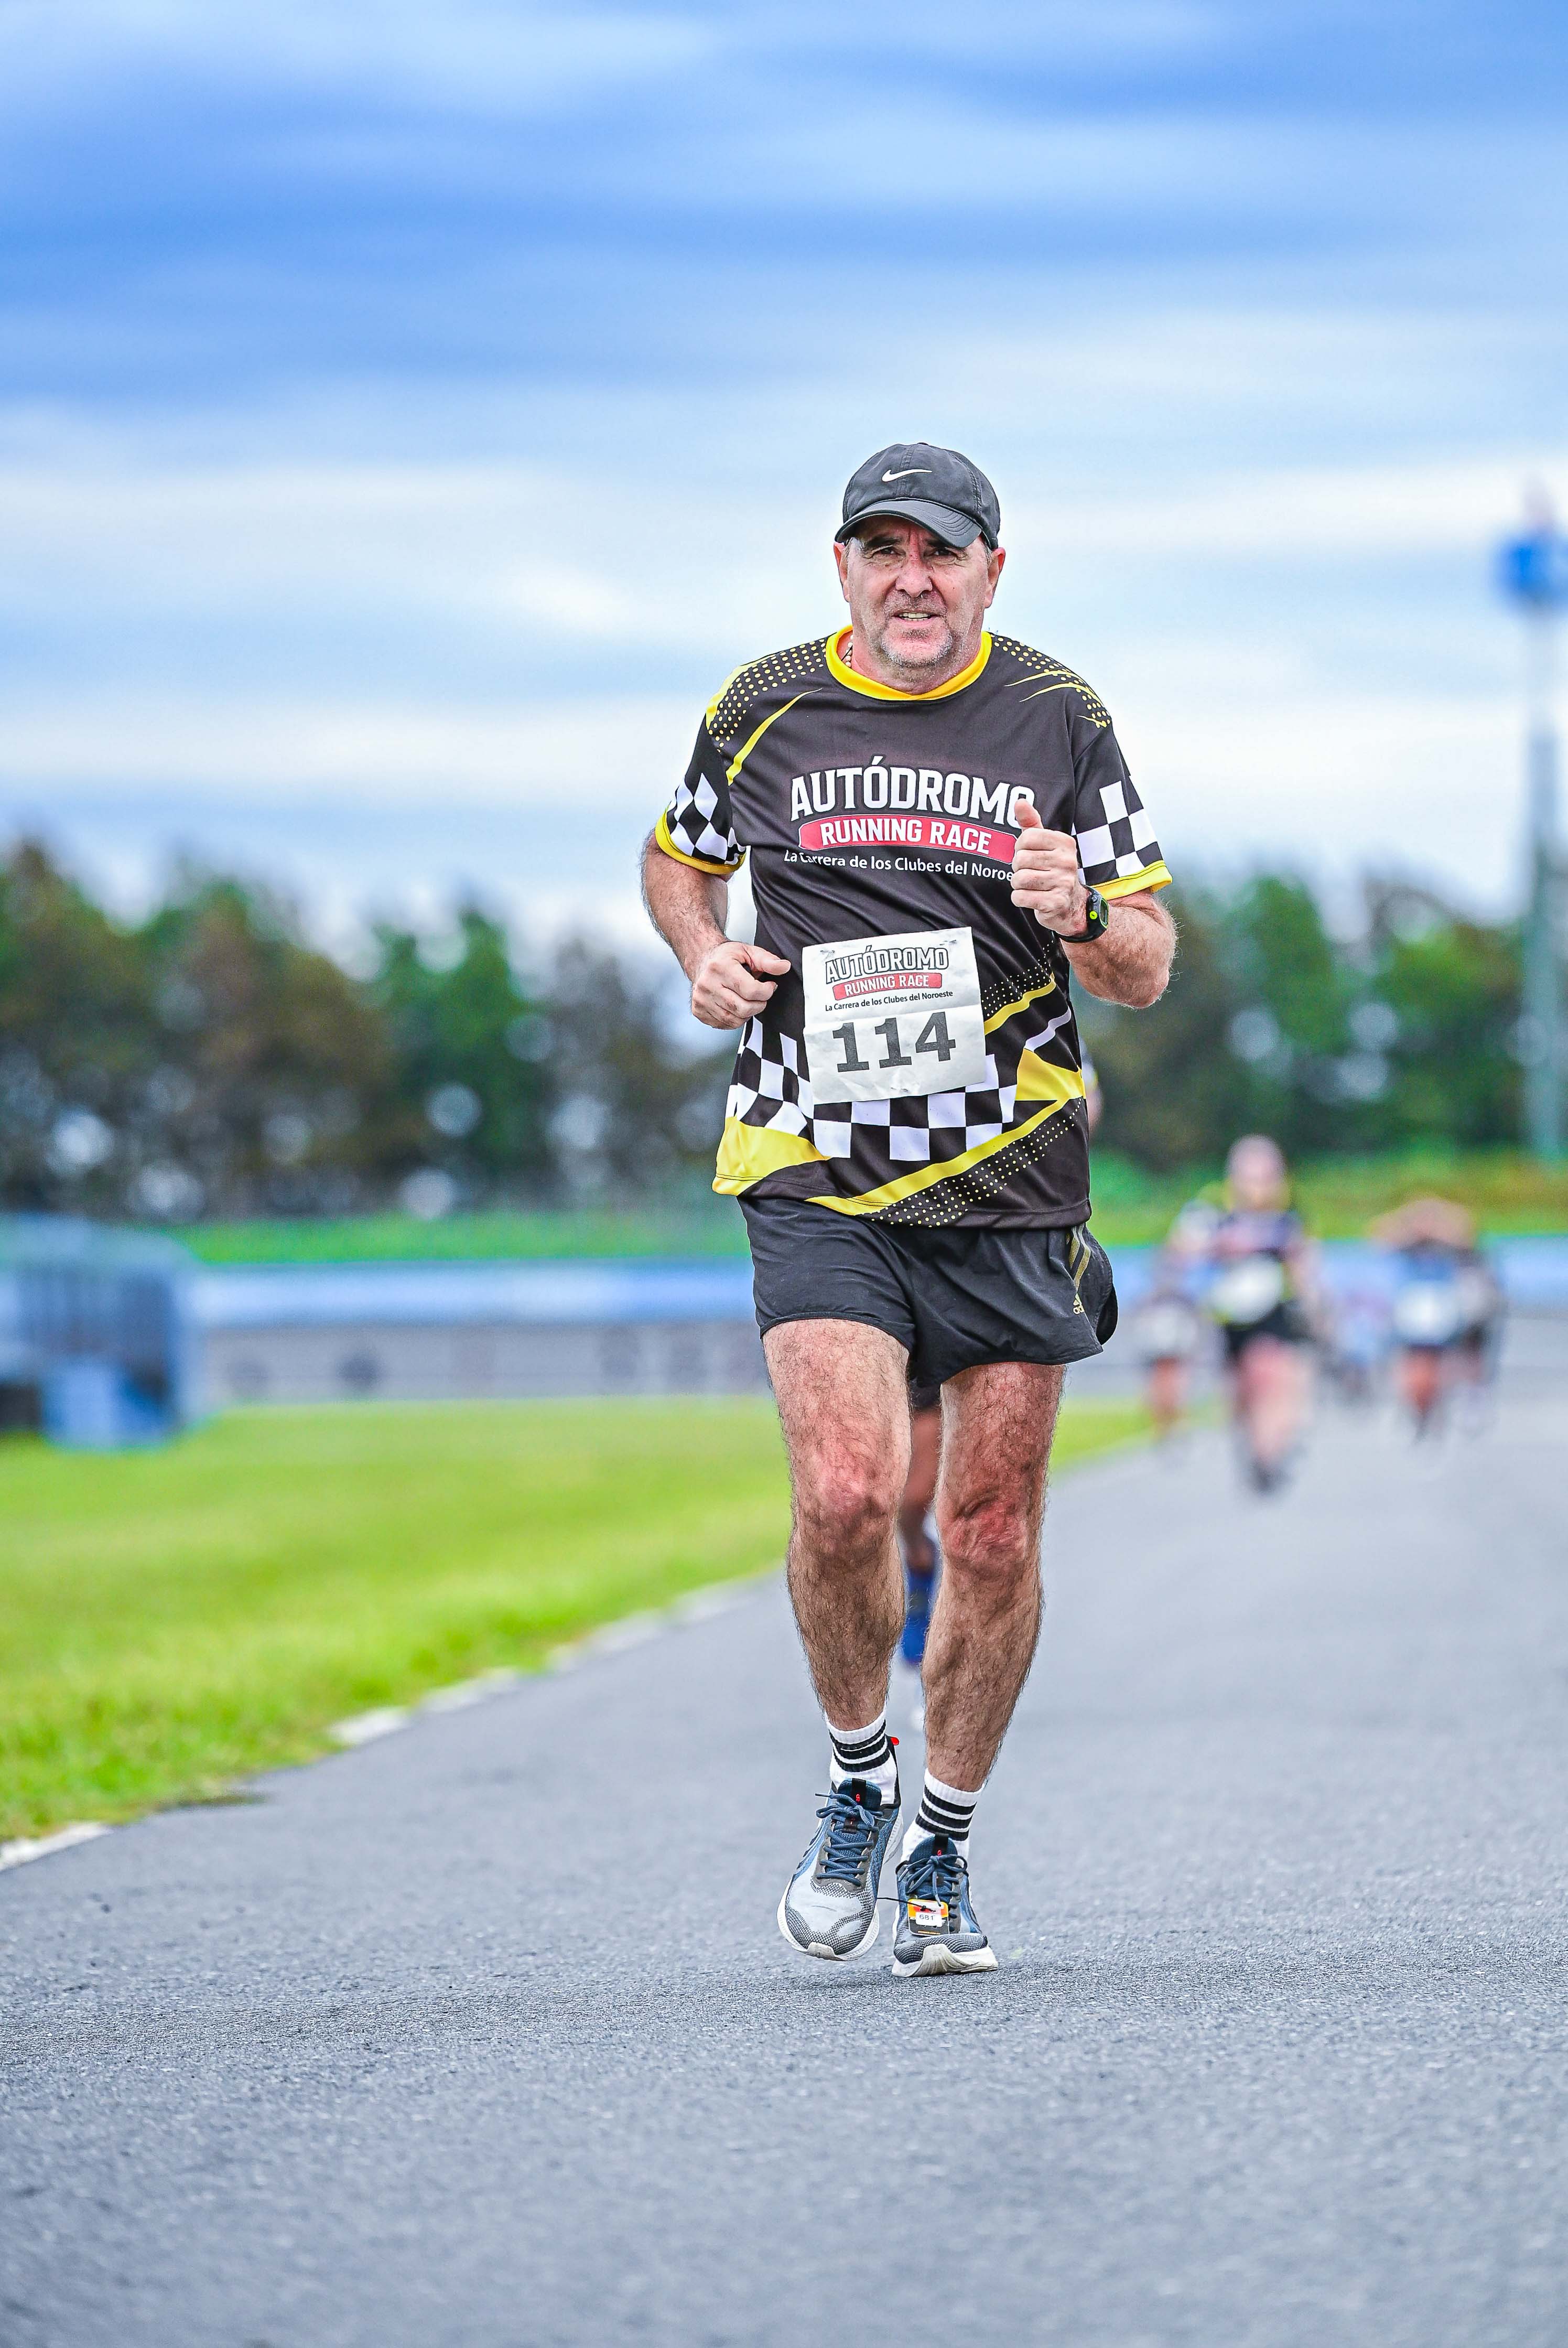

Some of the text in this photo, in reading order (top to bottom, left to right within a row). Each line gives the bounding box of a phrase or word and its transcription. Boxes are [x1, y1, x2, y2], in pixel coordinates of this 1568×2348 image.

[791, 756, 1035, 829] AUTÓDROMO
[820, 817, 992, 855] RUNNING RACE
[784, 849, 1013, 881] La Carrera de los Clubes del Noroe
[825, 945, 949, 985] AUTÓDROMO
[834, 1001, 860, 1010] Carrera
[883, 995, 908, 1004] Clubes
[909, 993, 921, 1001] del
[922, 990, 954, 999] Noroeste
[843, 974, 929, 997] RUNNING RACE
[832, 1011, 956, 1073] 114
